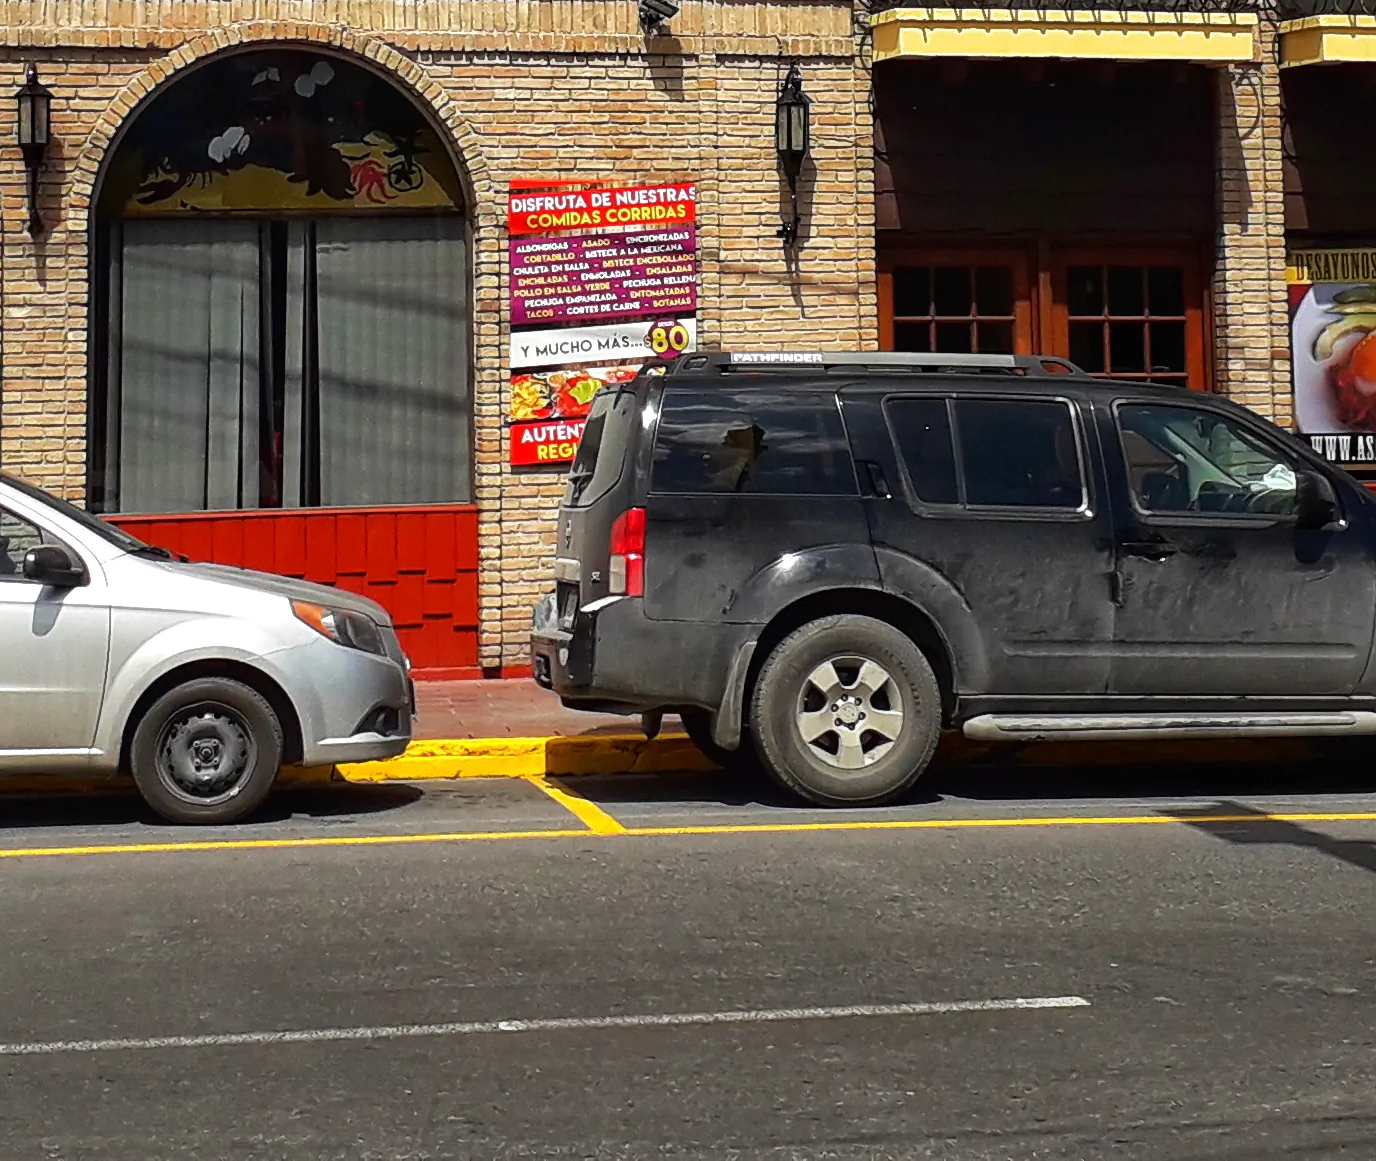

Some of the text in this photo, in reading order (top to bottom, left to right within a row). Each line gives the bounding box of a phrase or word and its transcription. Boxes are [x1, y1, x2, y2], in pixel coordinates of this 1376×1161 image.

[511, 186, 696, 213] DISFRUTA DE NUESTRAS
[526, 204, 686, 229] COMIDAS CORRIDAS
[582, 239, 610, 248] ASADO
[524, 252, 575, 263] CORTADILLO
[628, 247, 638, 255] LA
[513, 265, 549, 275] CHULETA
[551, 264, 563, 272] EN
[564, 262, 590, 271] SALSA
[646, 265, 692, 275] ENSALADAS
[513, 288, 542, 297] POLLO
[544, 287, 555, 295] EN
[557, 285, 582, 293] SALSA
[623, 278, 661, 288] PECHUGA
[525, 298, 564, 307] PECHUGA
[526, 309, 554, 318] TACOS
[566, 305, 598, 315] CORTES
[600, 304, 611, 312] DE
[653, 297, 691, 307] BOTANAS
[521, 346, 529, 358] Y
[536, 340, 592, 357] MUCHO
